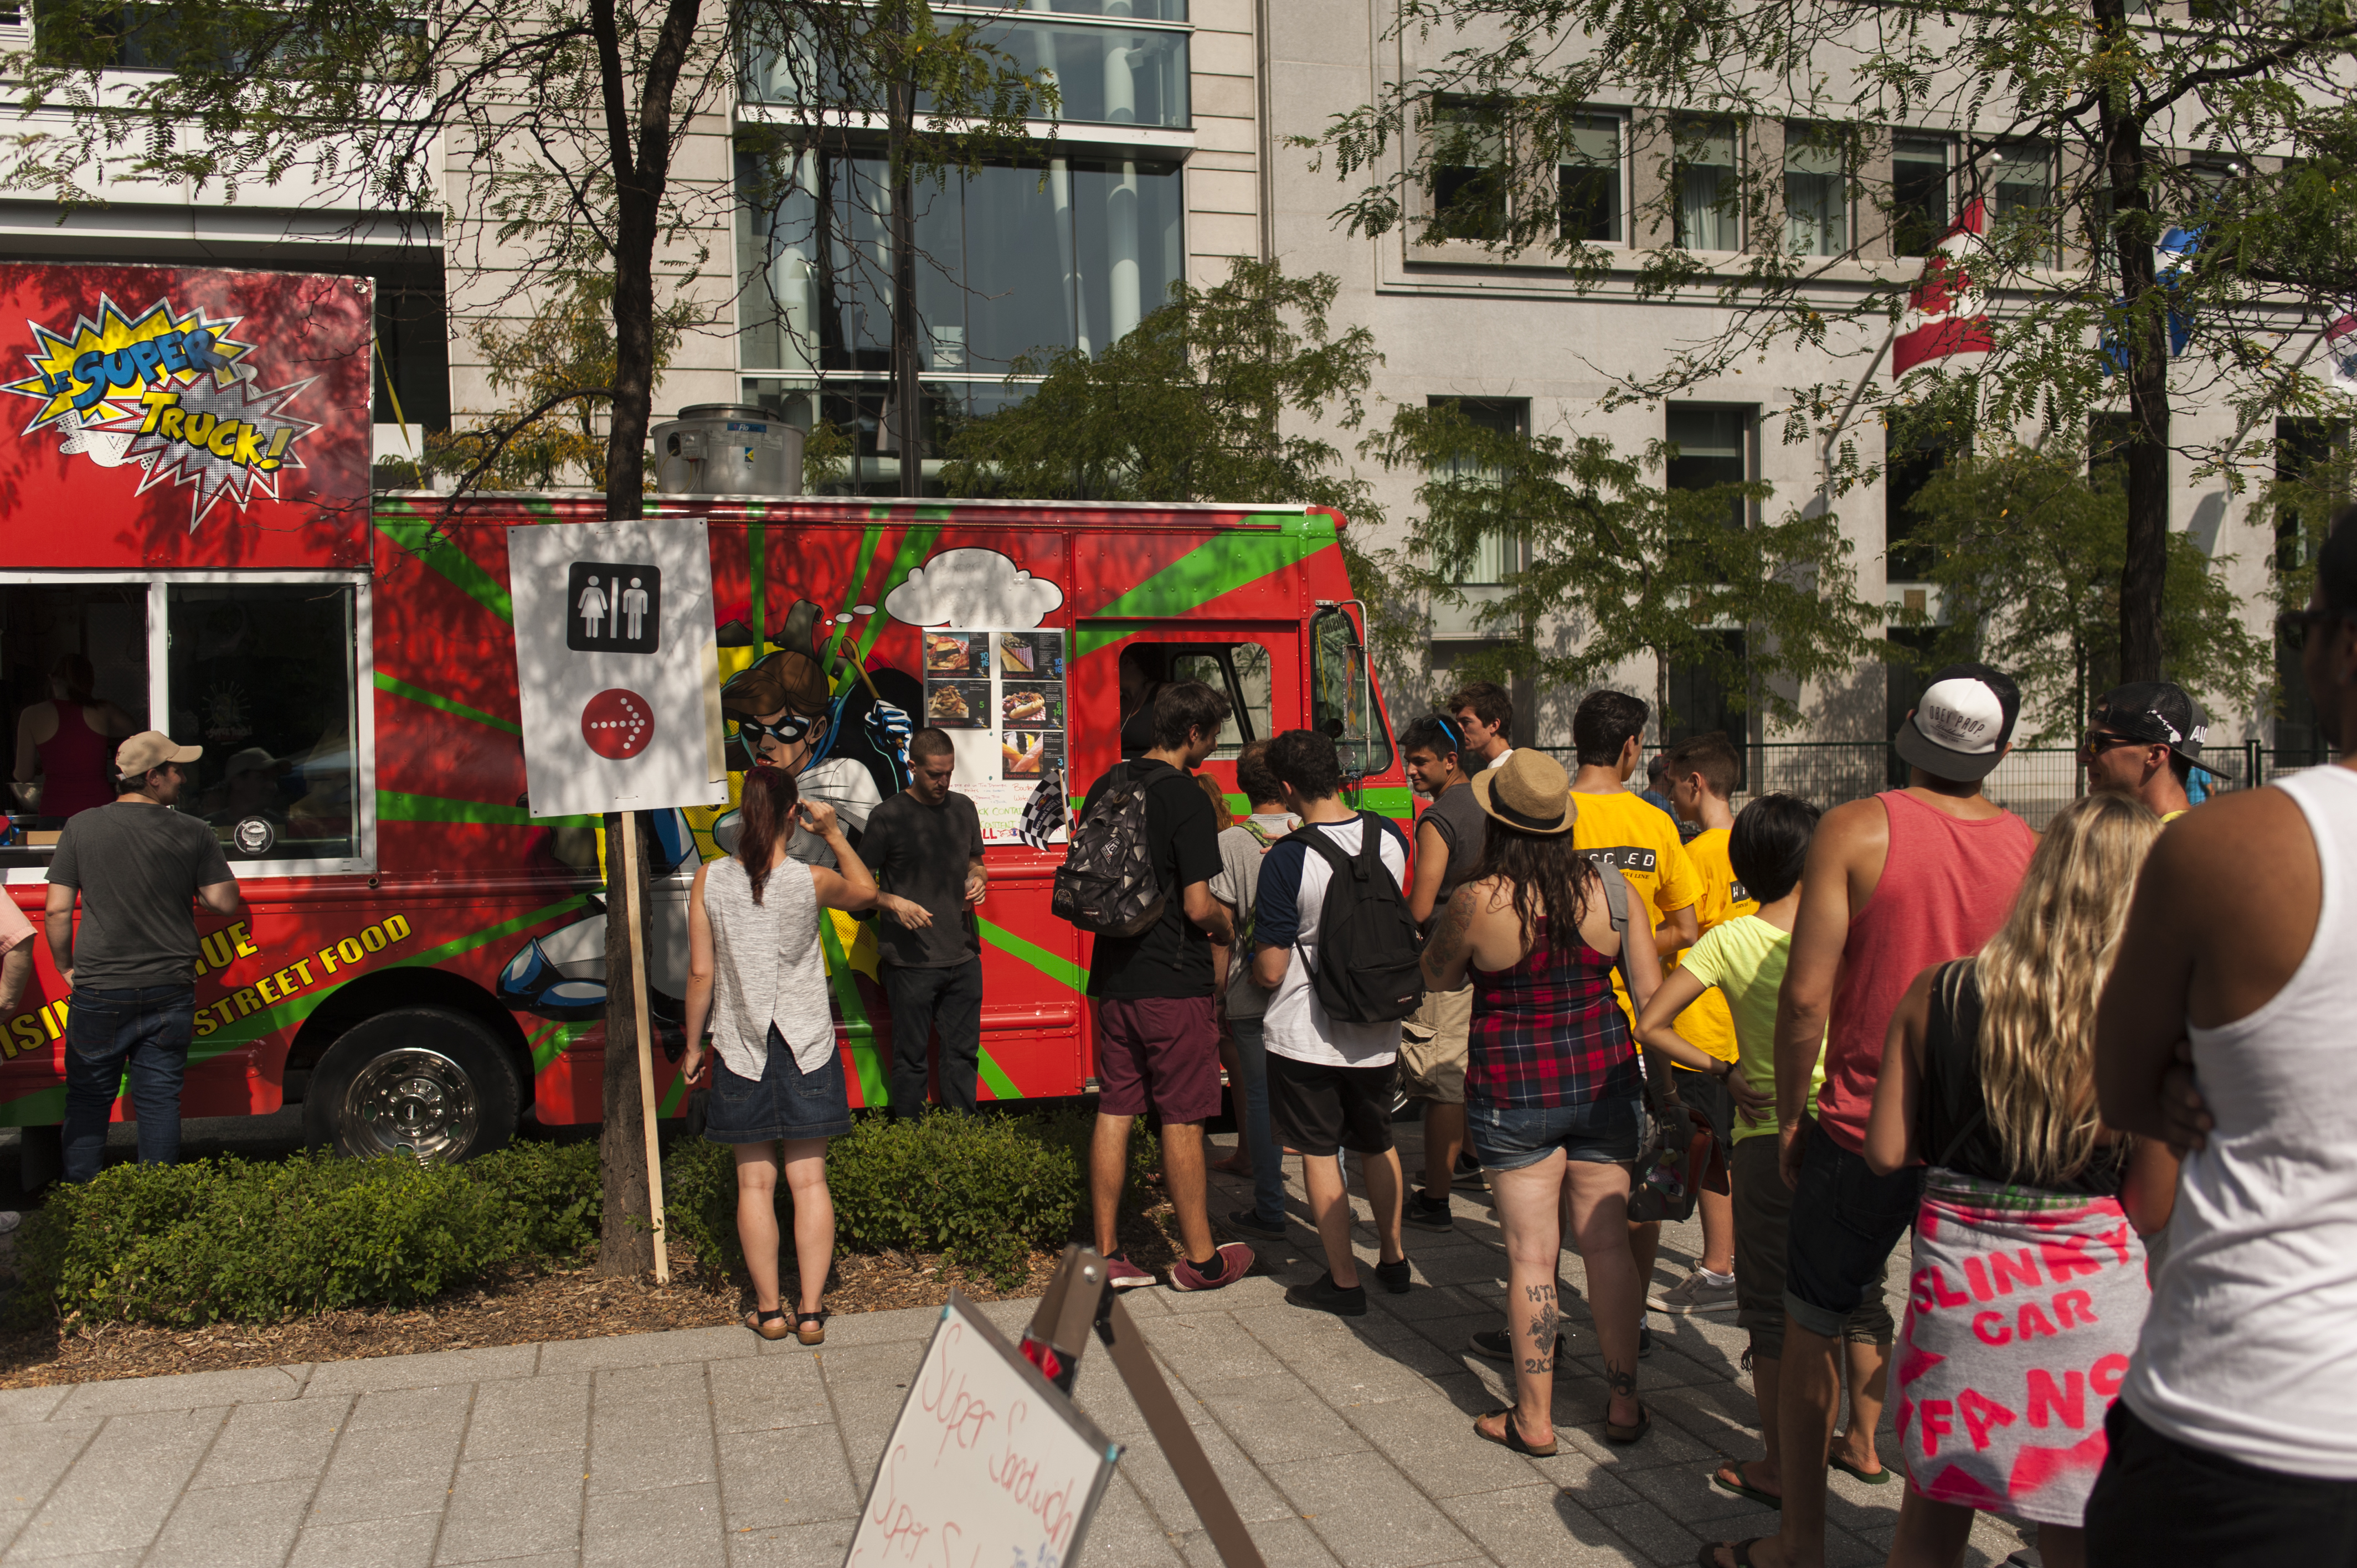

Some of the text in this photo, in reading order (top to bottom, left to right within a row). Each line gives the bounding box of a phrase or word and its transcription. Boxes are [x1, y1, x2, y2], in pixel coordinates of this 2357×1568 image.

[42, 329, 231, 411] LE SUPER
[138, 390, 295, 472] TRUCK!
[980, 652, 989, 660] 10
[980, 659, 990, 668] 16
[979, 700, 985, 709] 5
[1056, 701, 1062, 709] 8
[1929, 705, 1985, 737] OBEY PROP.
[1058, 758, 1063, 766] 3
[981, 828, 997, 839] LL
[192, 914, 413, 1037] STREET FOOD
[1911, 1222, 2130, 1314] SLINKY
